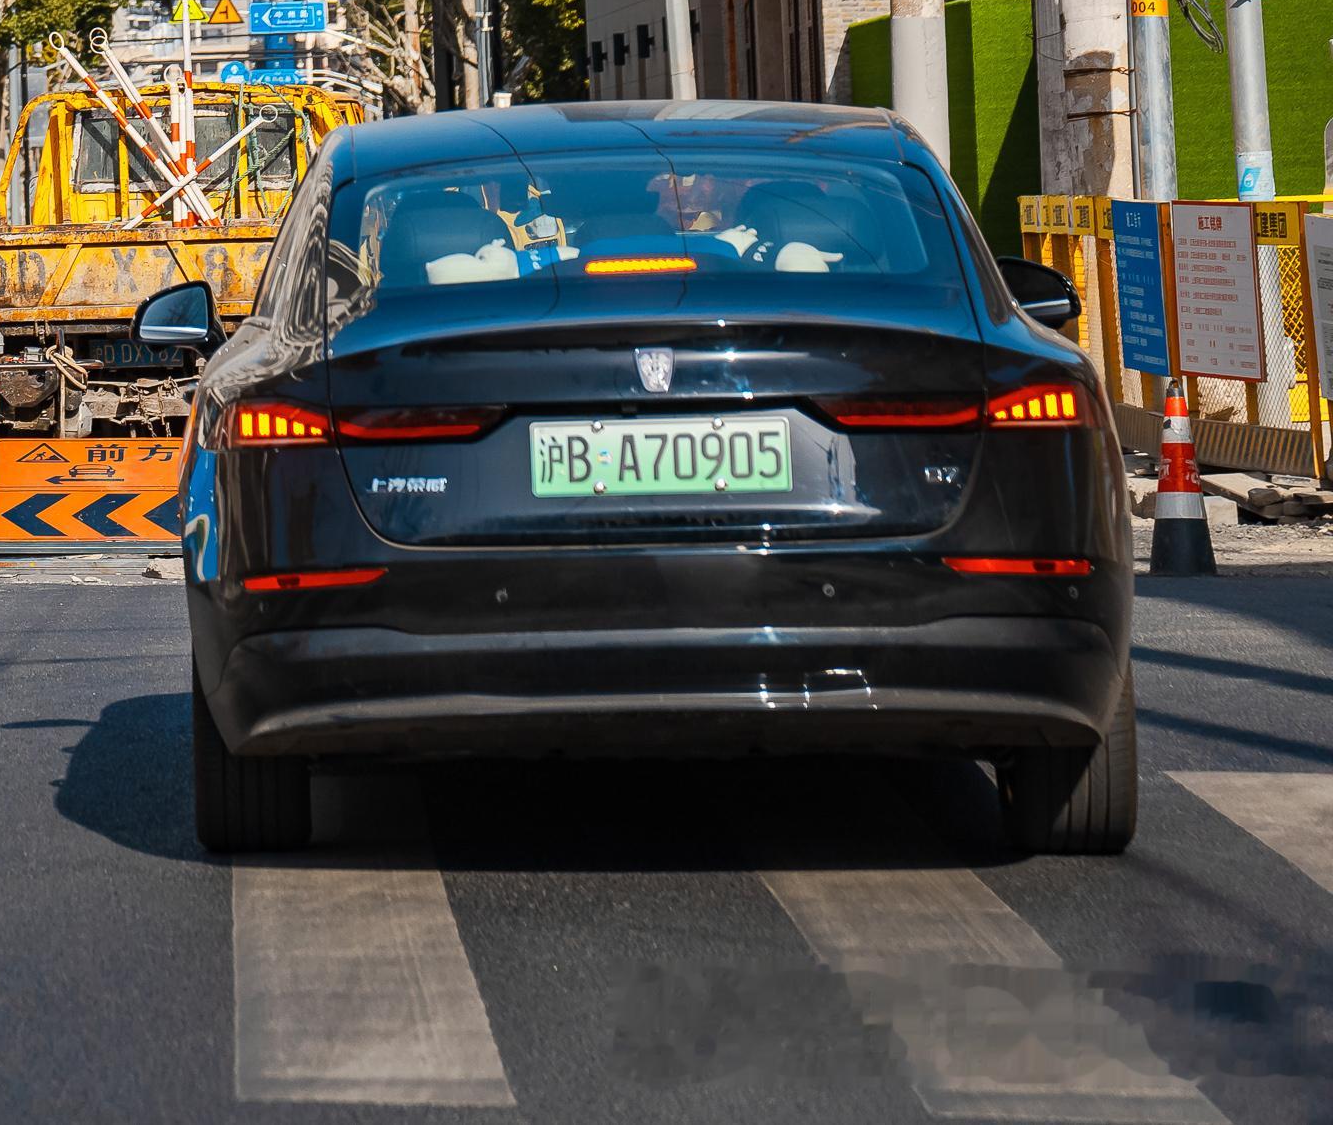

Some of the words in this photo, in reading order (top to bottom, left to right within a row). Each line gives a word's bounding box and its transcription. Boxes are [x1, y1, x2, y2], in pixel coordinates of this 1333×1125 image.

[1132, 1, 1156, 13] 004
[84, 443, 180, 463] 前方
[540, 434, 593, 484] 沪B
[618, 431, 783, 482] A70905
